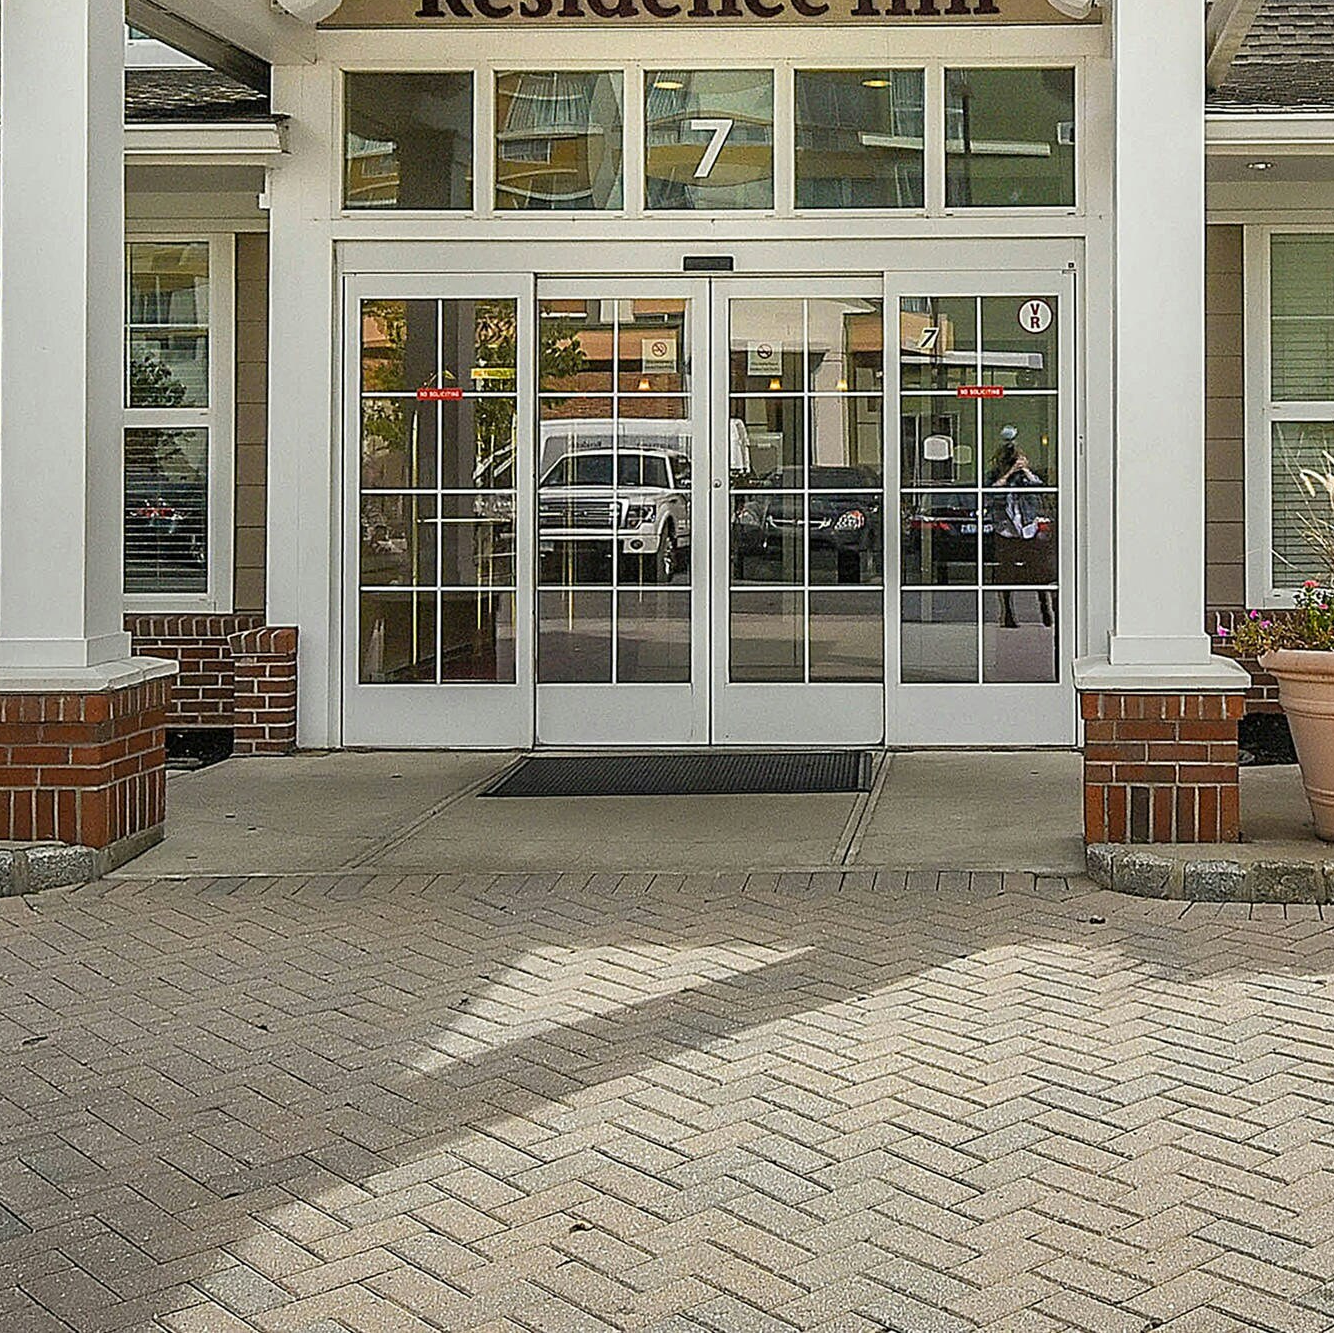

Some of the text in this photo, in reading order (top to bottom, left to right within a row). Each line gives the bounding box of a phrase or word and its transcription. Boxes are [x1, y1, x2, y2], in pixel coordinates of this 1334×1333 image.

[690, 119, 734, 178] 7
[1028, 303, 1041, 315] V
[1029, 316, 1041, 329] R
[919, 327, 939, 348] 7
